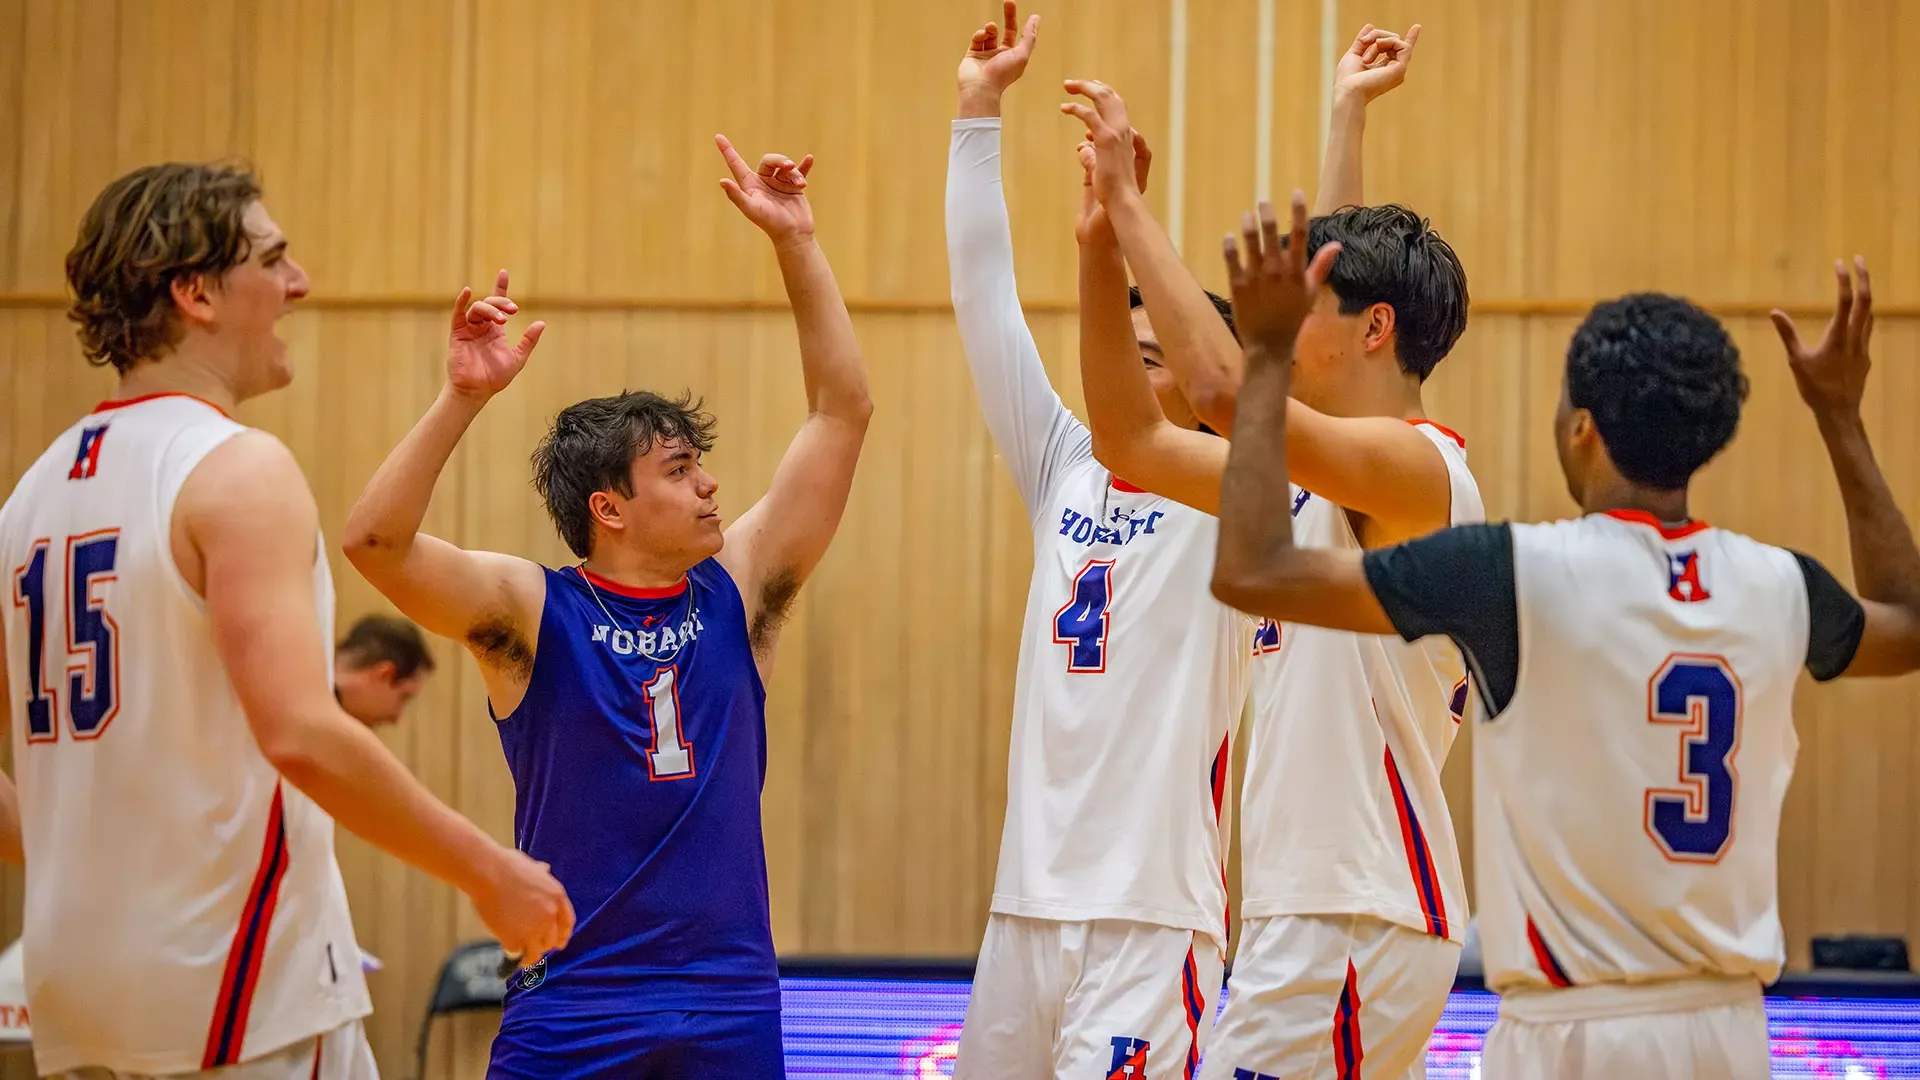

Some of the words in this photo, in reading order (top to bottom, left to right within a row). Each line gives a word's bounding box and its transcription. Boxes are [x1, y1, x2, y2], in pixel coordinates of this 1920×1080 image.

[13, 527, 121, 744] 15
[1053, 558, 1116, 674] 4
[642, 664, 696, 782] 1
[1644, 652, 1743, 865] 3
